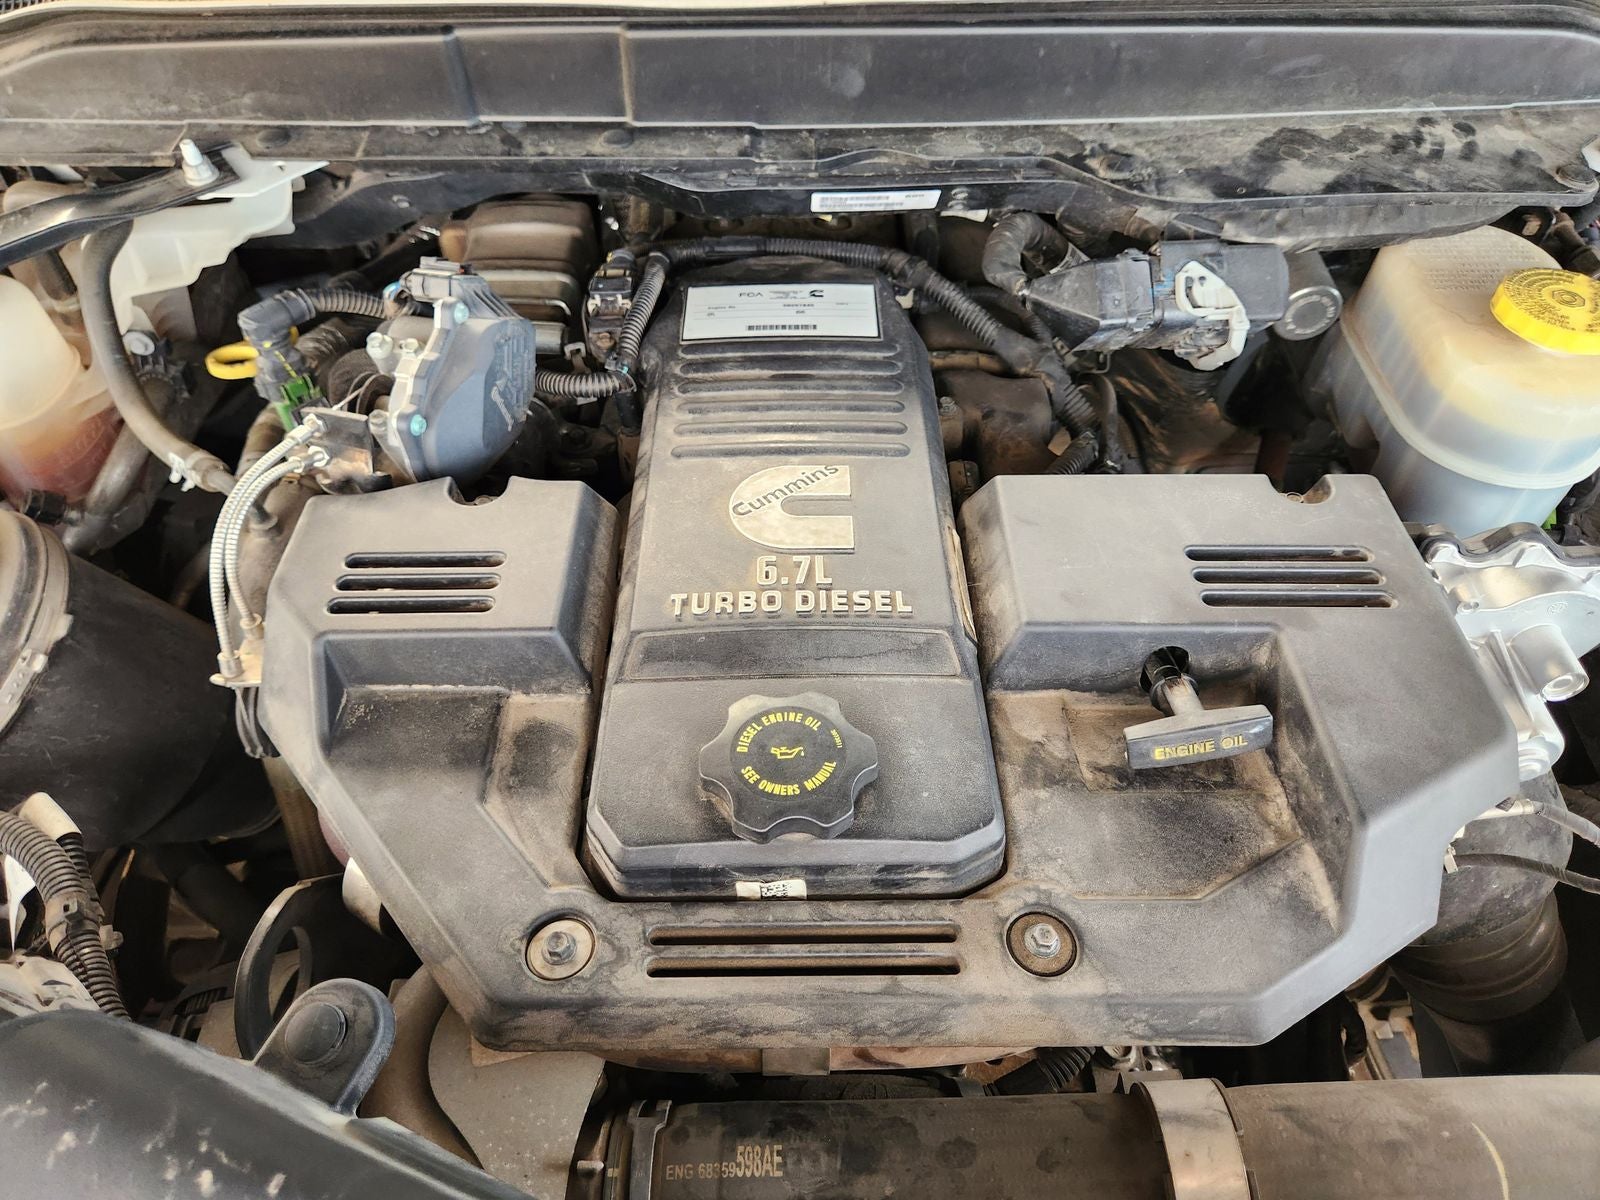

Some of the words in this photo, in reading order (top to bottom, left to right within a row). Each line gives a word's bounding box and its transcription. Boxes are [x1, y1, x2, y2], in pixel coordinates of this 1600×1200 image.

[732, 464, 839, 516] Cummins
[756, 555, 833, 586] 6.7L
[670, 590, 782, 617] TURBO
[795, 589, 913, 614] DIESEL
[736, 723, 763, 753] DIESEL
[761, 711, 804, 726] ENGINE
[804, 716, 822, 731] OIL
[1153, 738, 1216, 760] ENGINE
[1220, 734, 1248, 749] OIL
[741, 765, 761, 784] SEE
[758, 779, 801, 796] OWNERS
[803, 761, 837, 791] MANUAL
[665, 1163, 694, 1180] ENG
